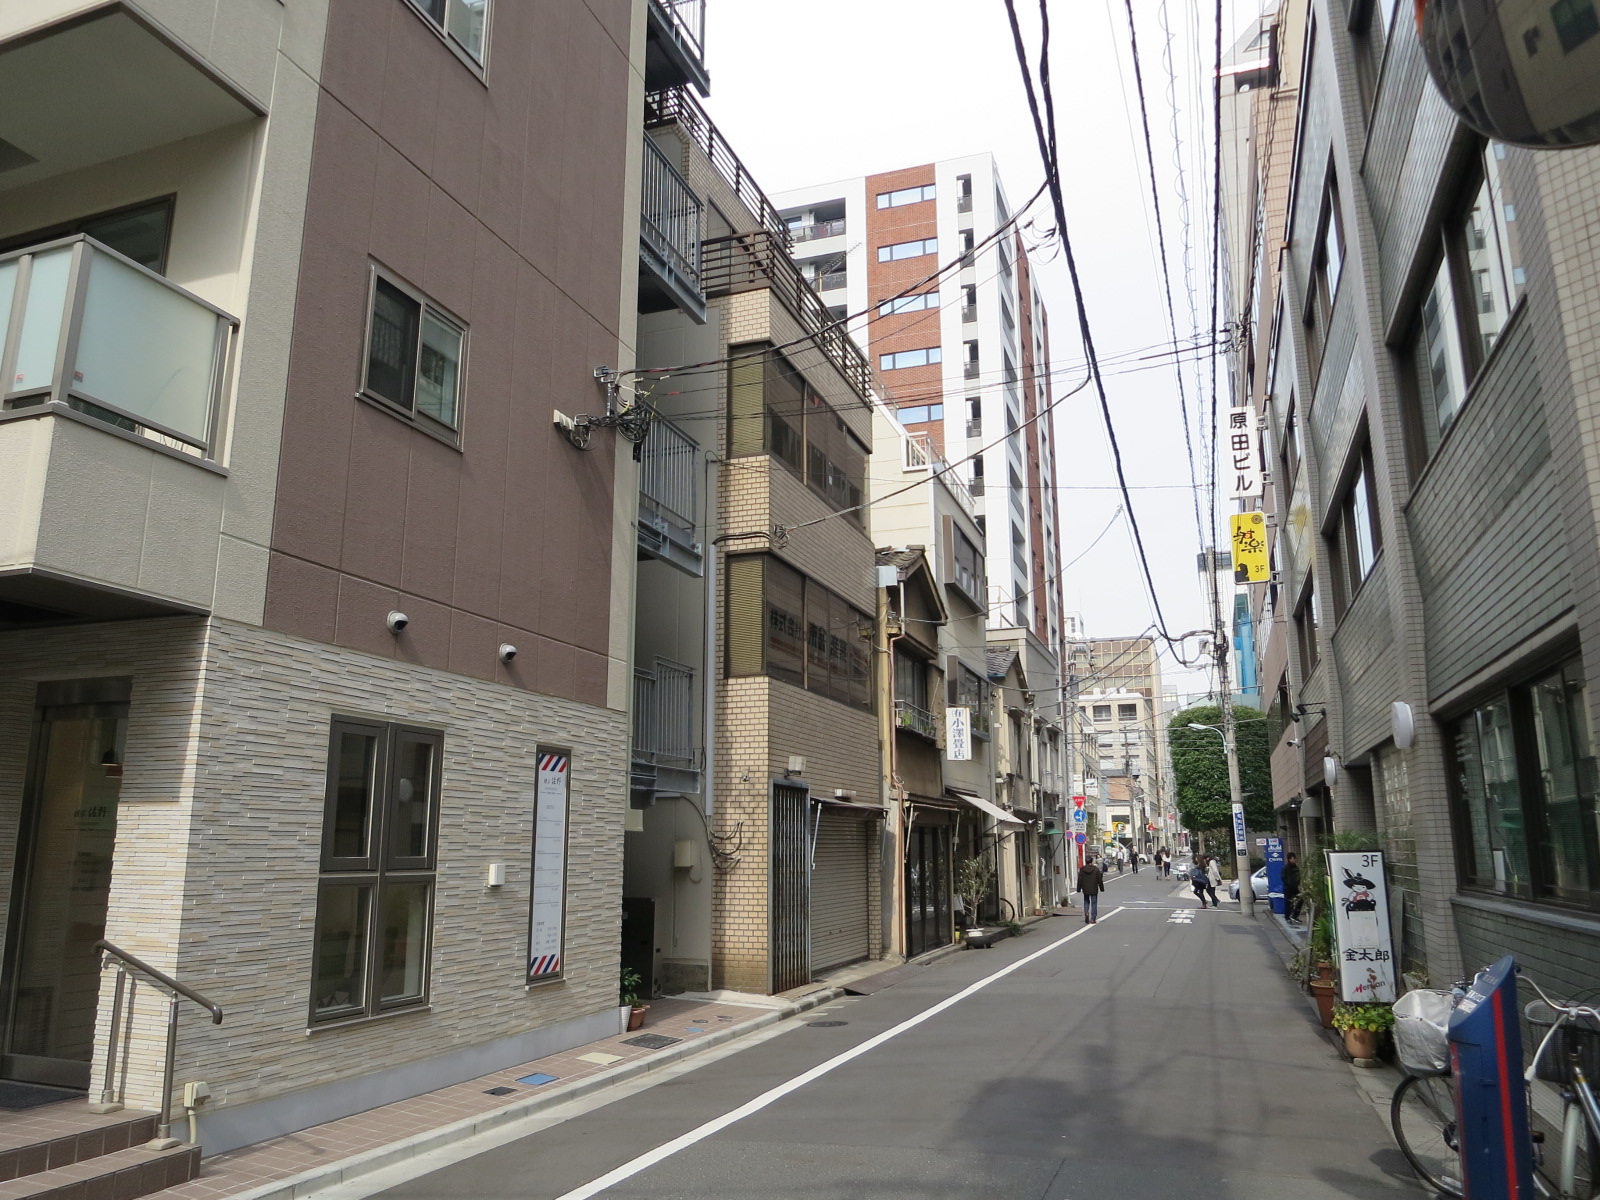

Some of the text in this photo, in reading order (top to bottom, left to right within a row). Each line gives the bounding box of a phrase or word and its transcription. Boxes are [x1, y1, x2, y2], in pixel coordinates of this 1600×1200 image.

[1229, 411, 1253, 492] 原田ビル
[1254, 565, 1265, 573] 3F
[1361, 854, 1378, 868] 3F
[1343, 948, 1390, 963] 金太郎
[1352, 980, 1386, 995] Meran
